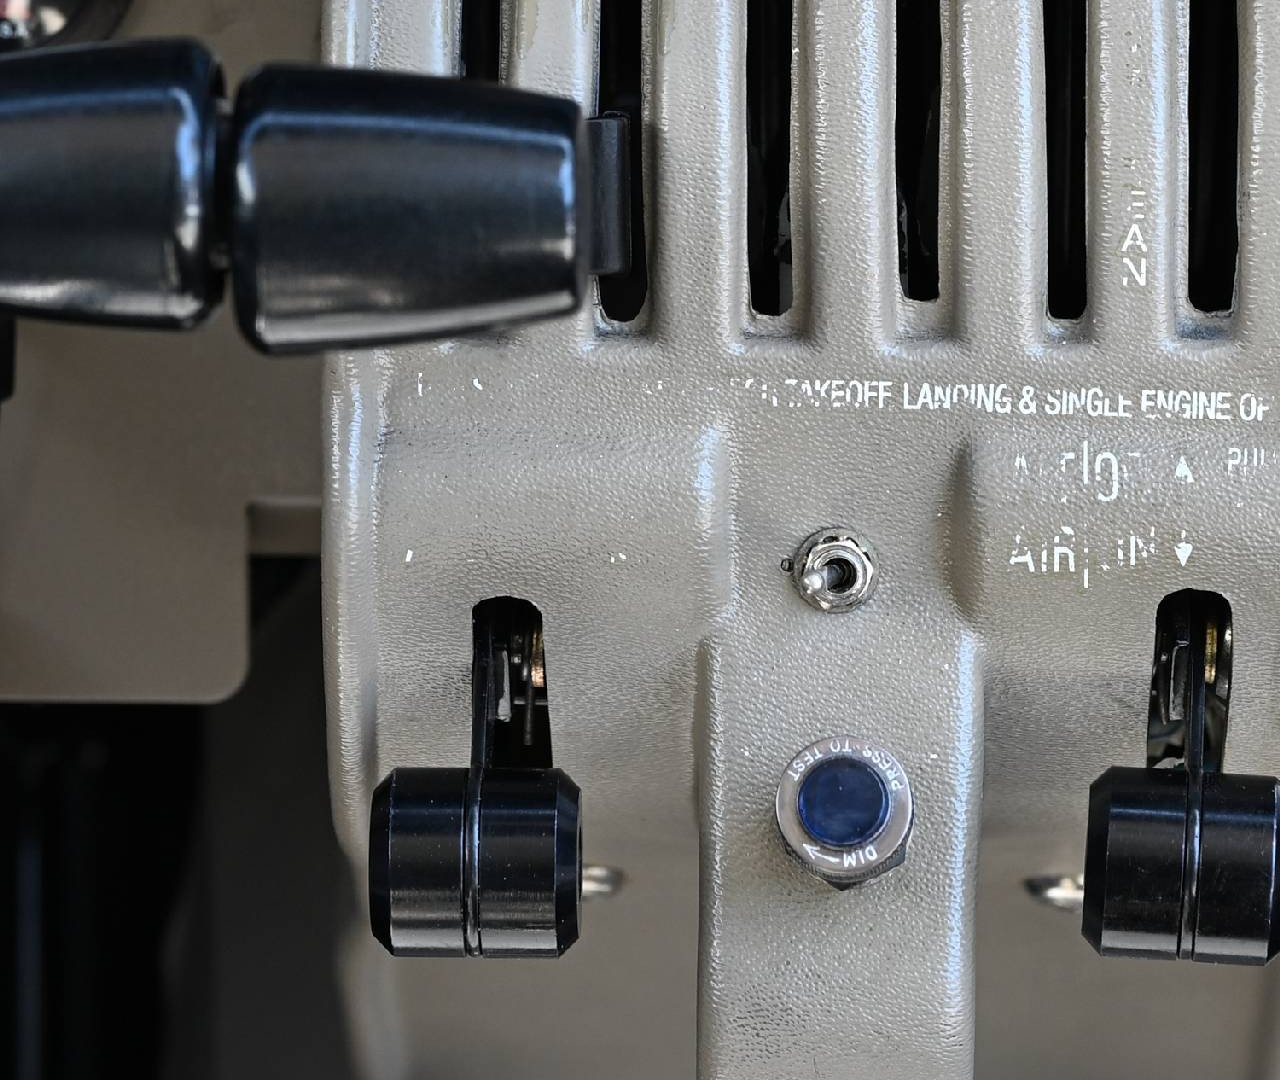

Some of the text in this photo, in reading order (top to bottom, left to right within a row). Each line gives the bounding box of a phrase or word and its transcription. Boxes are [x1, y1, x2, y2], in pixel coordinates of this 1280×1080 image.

[903, 383, 1012, 414] LANDING
[1019, 385, 1037, 415] &
[1141, 390, 1232, 419] ENGINE
[830, 739, 852, 753] TO
[788, 747, 823, 781] TEST
[843, 845, 878, 868] DIM
